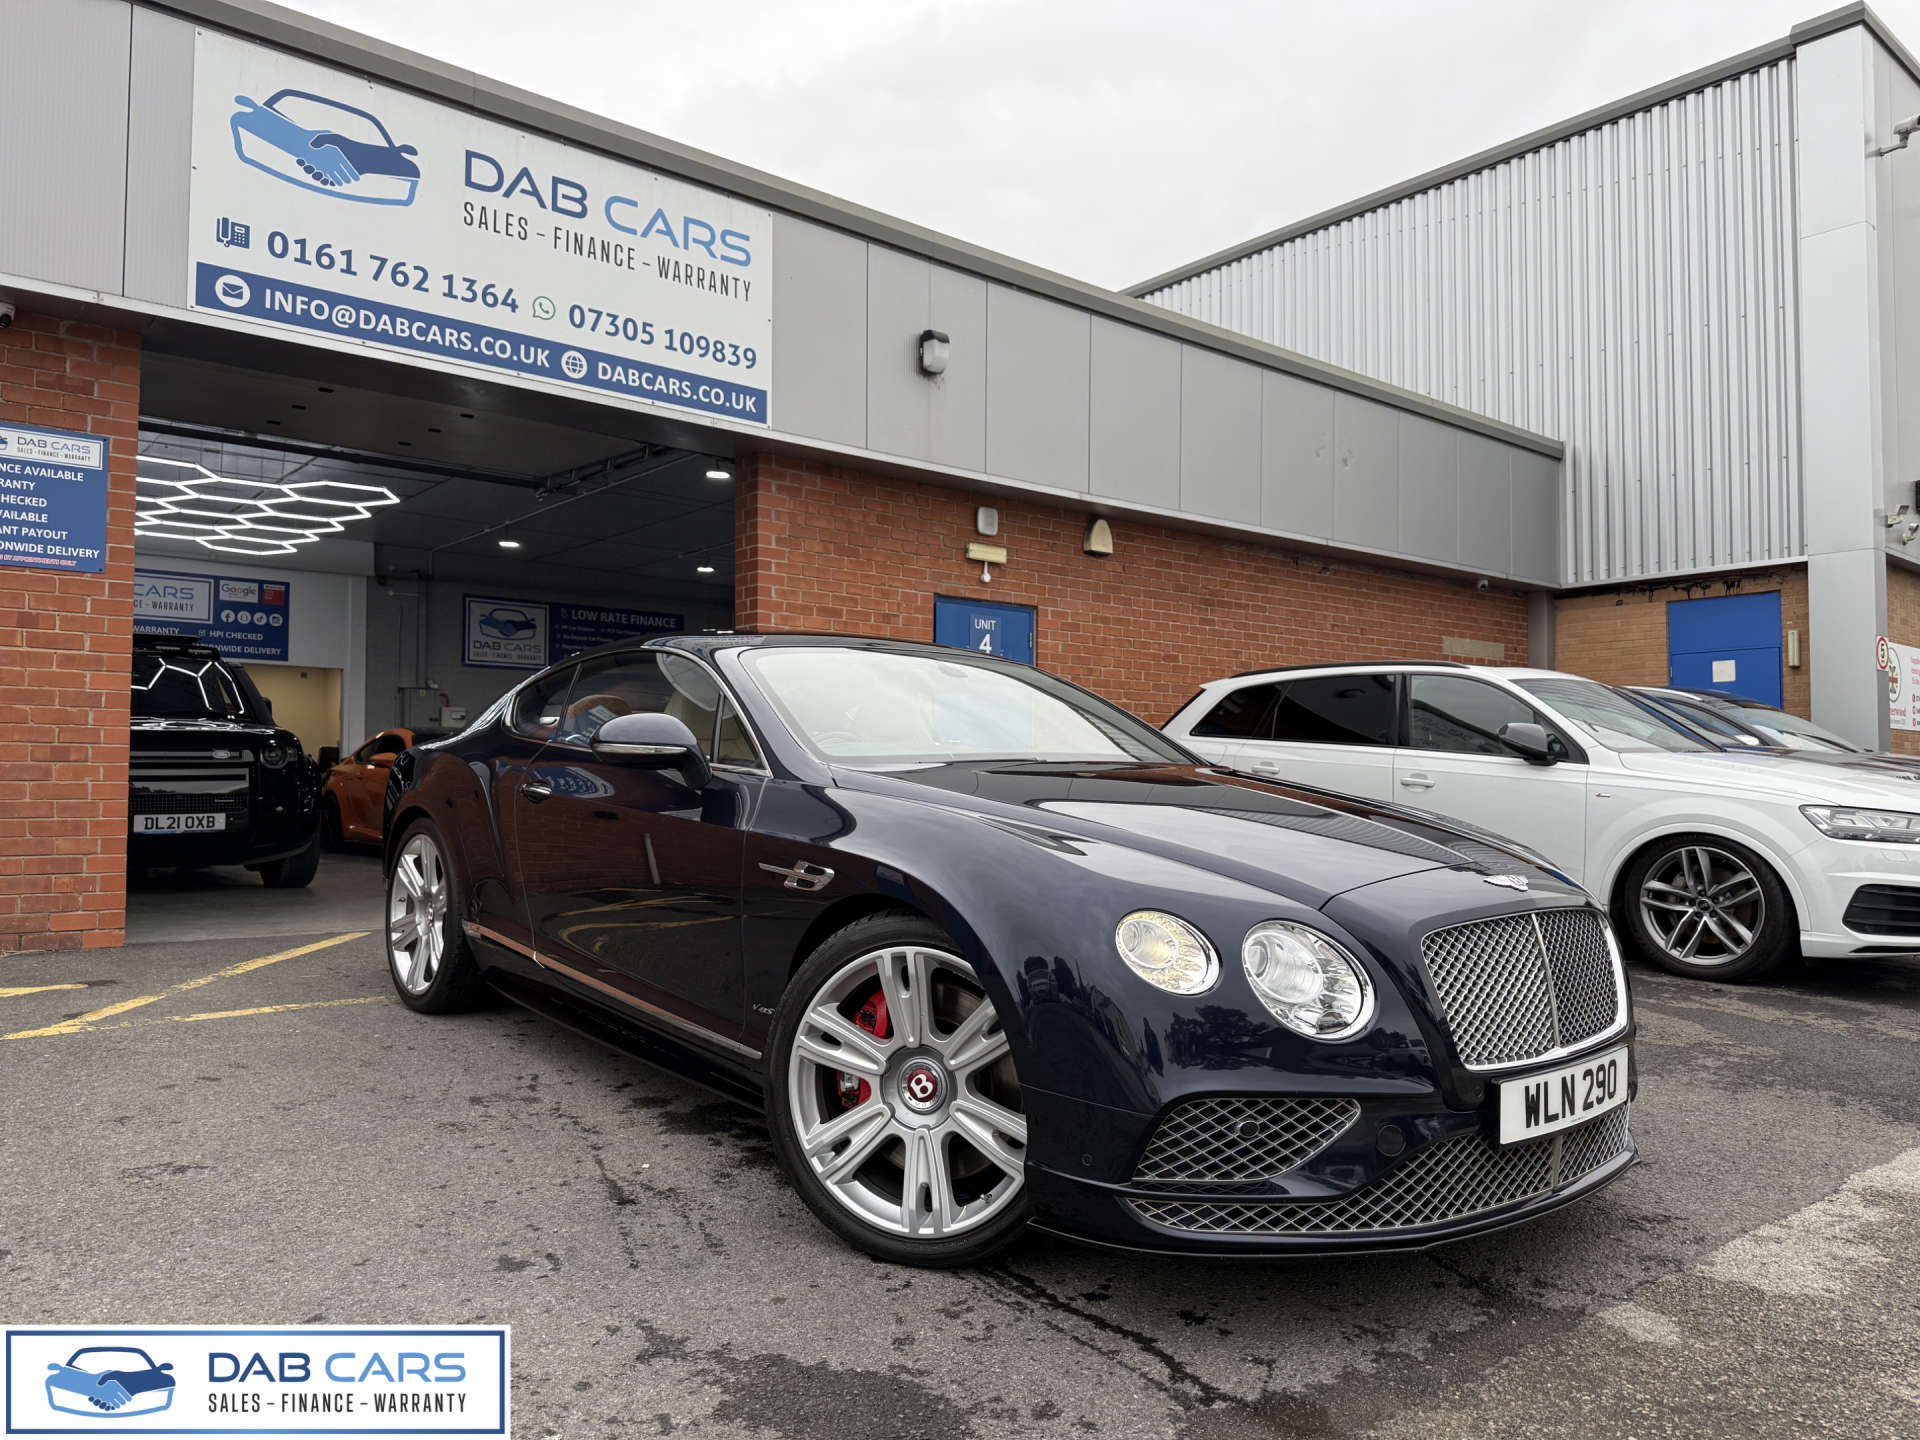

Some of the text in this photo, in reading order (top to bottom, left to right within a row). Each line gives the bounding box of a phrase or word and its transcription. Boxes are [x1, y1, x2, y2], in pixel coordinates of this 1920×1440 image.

[464, 149, 751, 267] DAB CARS
[463, 201, 528, 241] SALES
[553, 225, 636, 271] FINANCE
[657, 255, 751, 302] WARRANTY
[267, 230, 519, 314] 0161 762 1364
[265, 288, 550, 368] INFO@DABCARS.CO.UK
[568, 304, 757, 370] 07305 109839
[597, 361, 757, 413] DABCARS.CO.UK
[17, 437, 91, 454] DAB CARS
[24, 466, 84, 482] AVAILABLE
[22, 527, 68, 540] PAYOUT
[47, 545, 100, 559] DELIVERY
[221, 583, 257, 597] Google
[152, 600, 194, 612] WARRANTY
[571, 609, 677, 629] LOW RATE FINANCE
[974, 618, 997, 631] UNIT
[209, 630, 264, 641] HPI CHECKED
[978, 633, 993, 654] 4
[244, 646, 280, 656] DELIVERY
[144, 816, 180, 830] DL21
[1524, 1059, 1617, 1129] WLN 290
